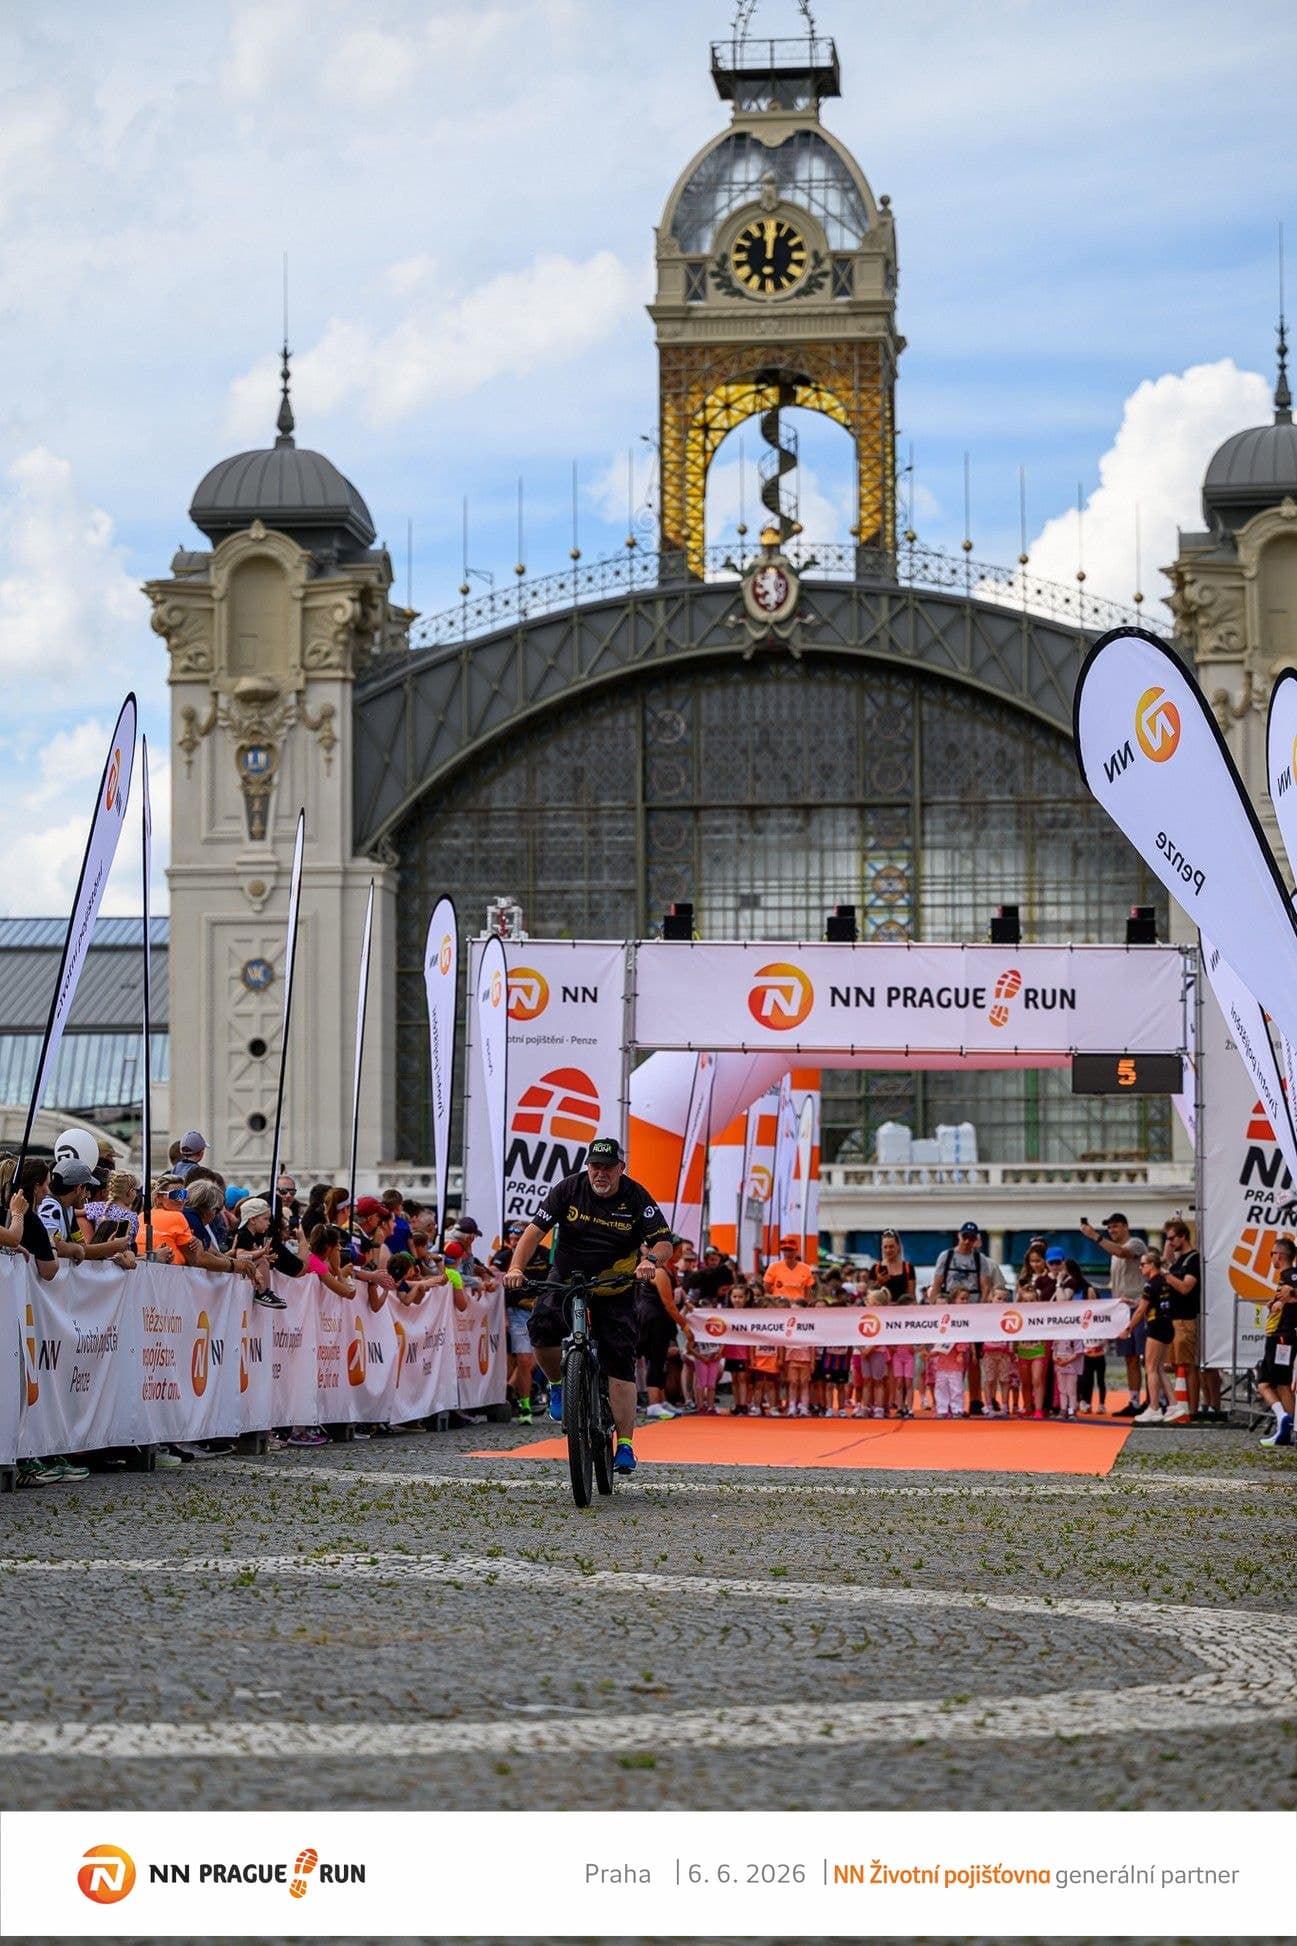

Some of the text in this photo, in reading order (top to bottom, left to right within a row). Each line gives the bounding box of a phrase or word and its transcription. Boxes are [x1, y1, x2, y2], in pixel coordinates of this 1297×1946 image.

[562, 986, 598, 1004] NN
[830, 987, 875, 1008] NN
[887, 987, 986, 1009] PRAGUE
[1025, 987, 1076, 1010] RUN
[525, 1035, 564, 1046] pojištění
[571, 1035, 598, 1045] Penze
[1117, 1059, 1137, 1086] 5
[507, 1180, 551, 1197] PRAG
[1245, 1189, 1275, 1203] PRA
[508, 1197, 543, 1217] RU
[731, 1322, 816, 1332] NN PRAGUE RUN
[886, 1319, 970, 1330] NN PRAGUE RUN
[1028, 1314, 1112, 1326] NN PRAGUE RUN
